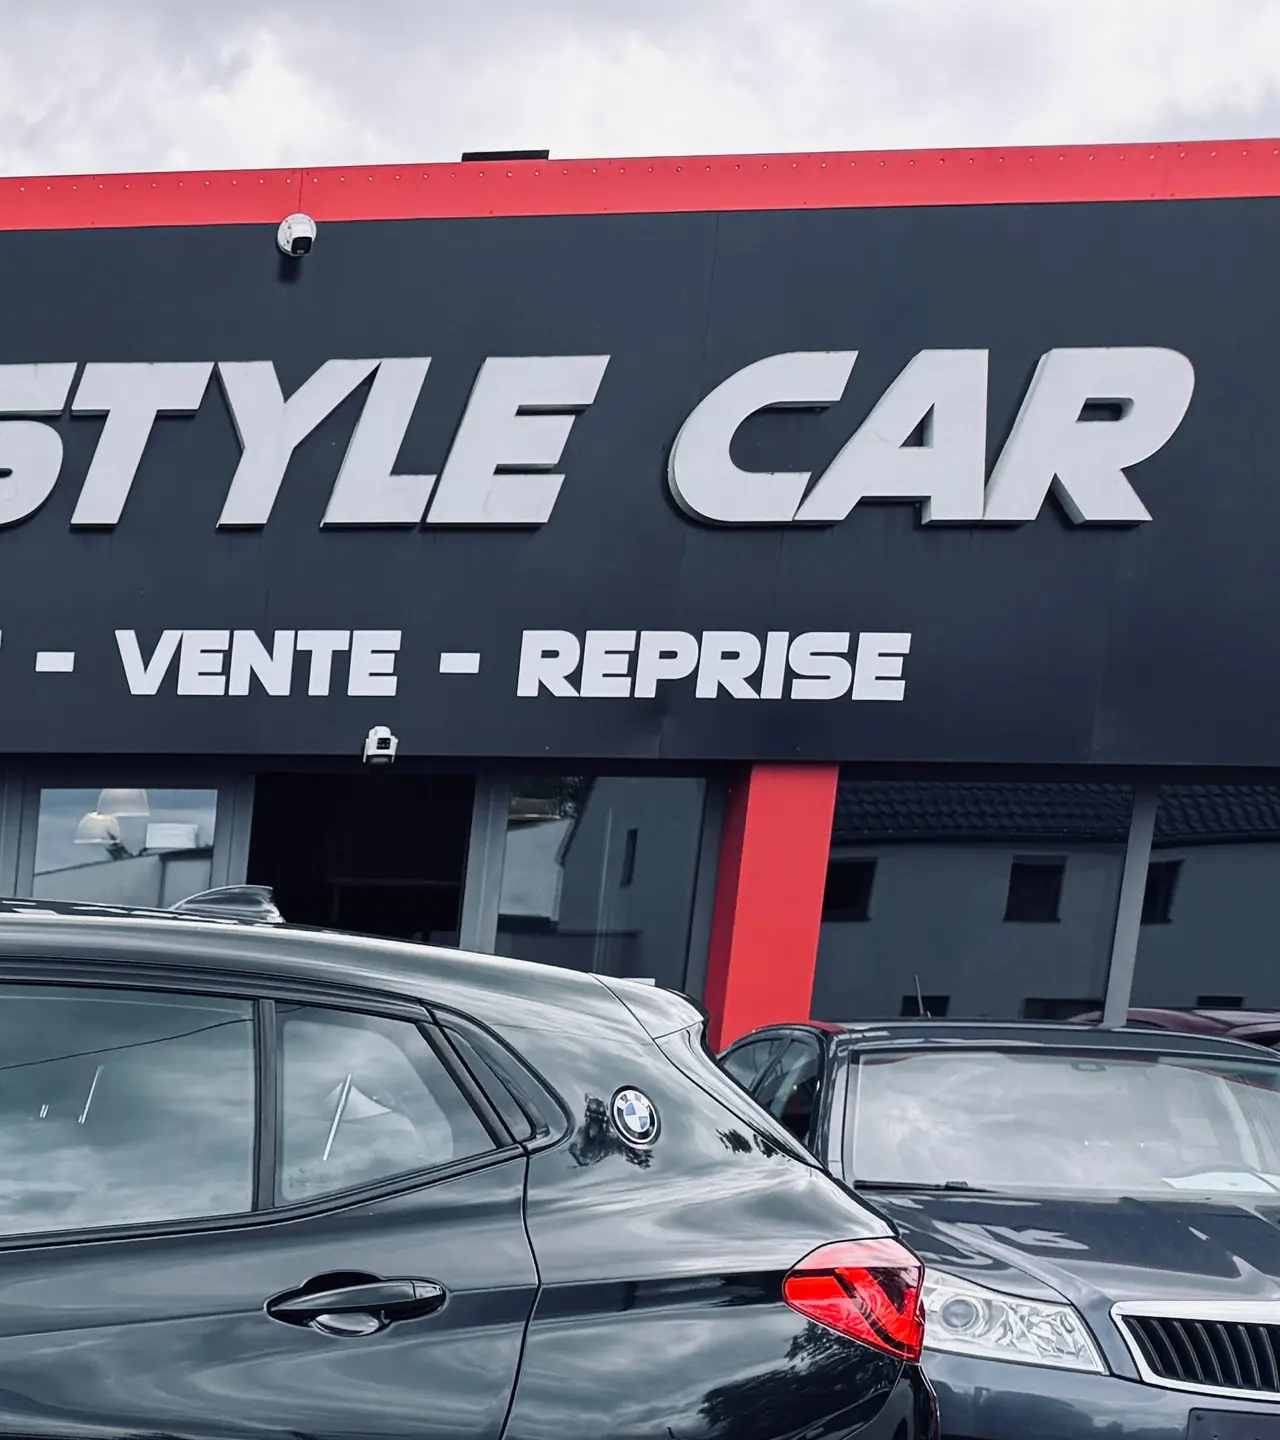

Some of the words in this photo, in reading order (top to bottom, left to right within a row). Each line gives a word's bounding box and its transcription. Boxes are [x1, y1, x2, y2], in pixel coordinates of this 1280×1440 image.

[667, 346, 1196, 526] CAR
[114, 629, 402, 697] VENTE
[516, 630, 912, 701] REPRISE
